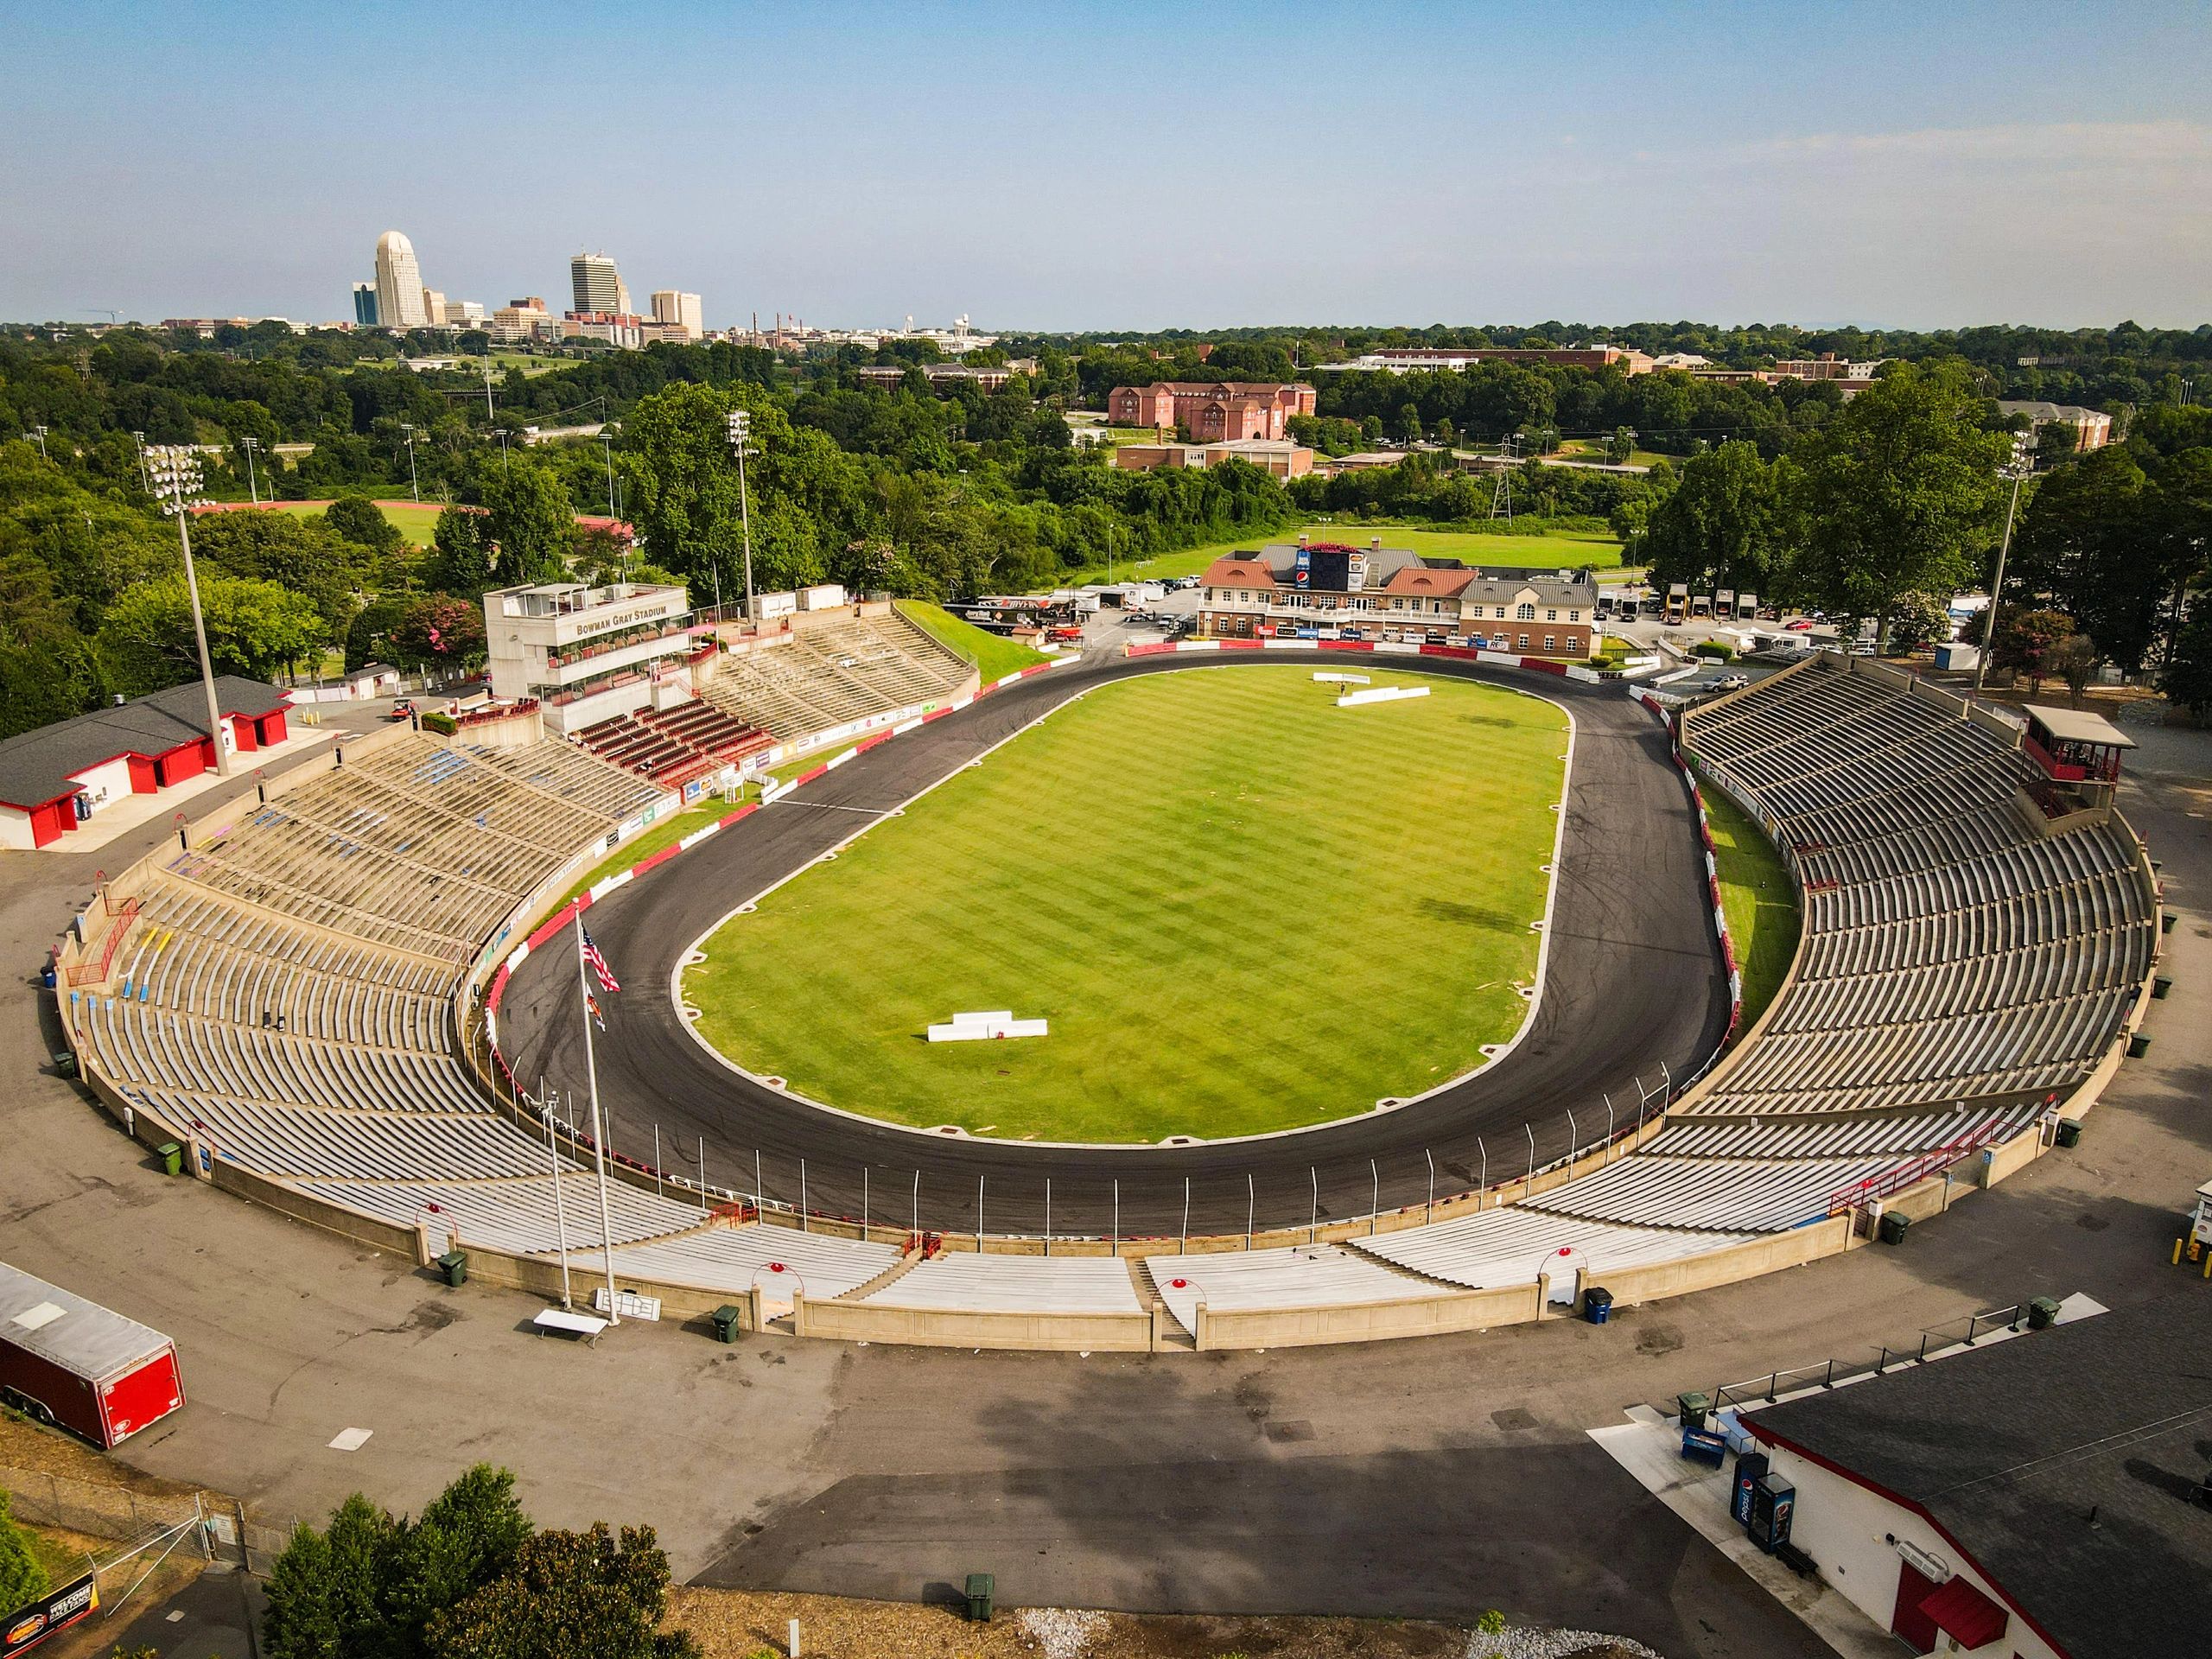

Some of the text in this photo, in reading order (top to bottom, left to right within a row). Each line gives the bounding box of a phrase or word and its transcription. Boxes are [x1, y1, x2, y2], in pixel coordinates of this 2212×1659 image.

[576, 606, 667, 635] BOWMAN GRAY STADIUM
[1741, 1492, 1751, 1522] pepsi
[49, 1592, 91, 1622] RACE FANS!
[50, 1586, 91, 1614] WELCOME
